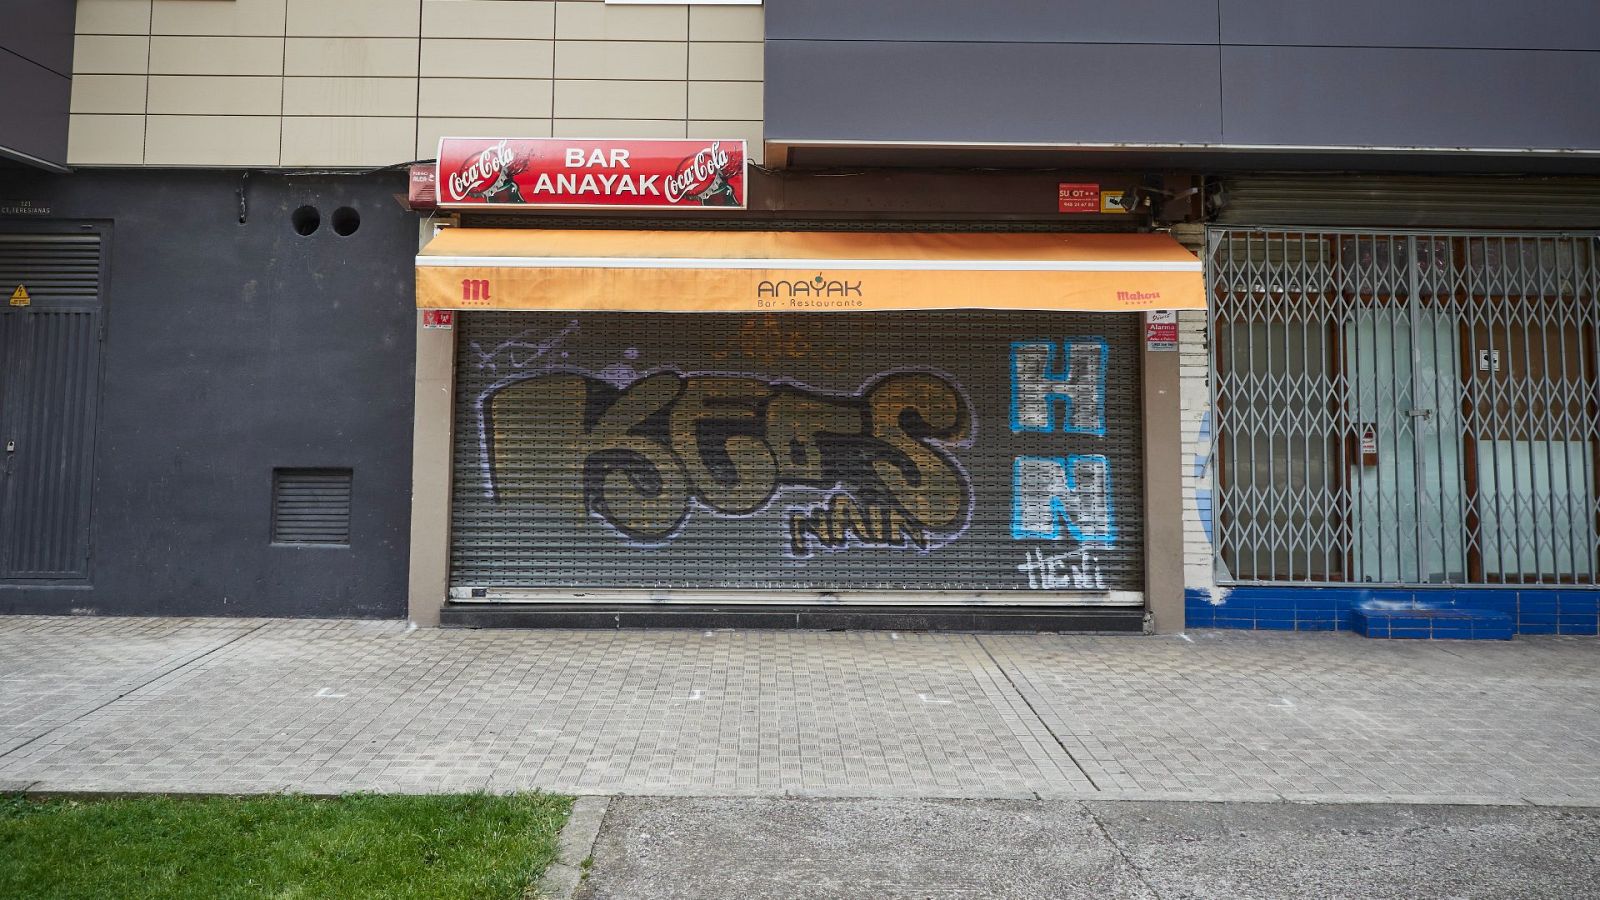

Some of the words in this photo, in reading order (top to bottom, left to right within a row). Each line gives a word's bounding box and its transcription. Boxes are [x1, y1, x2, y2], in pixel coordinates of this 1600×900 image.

[565, 148, 631, 168] BAR
[533, 173, 661, 196] ANAYAK
[758, 280, 862, 297] ANAYAK
[790, 299, 863, 307] Restaurante
